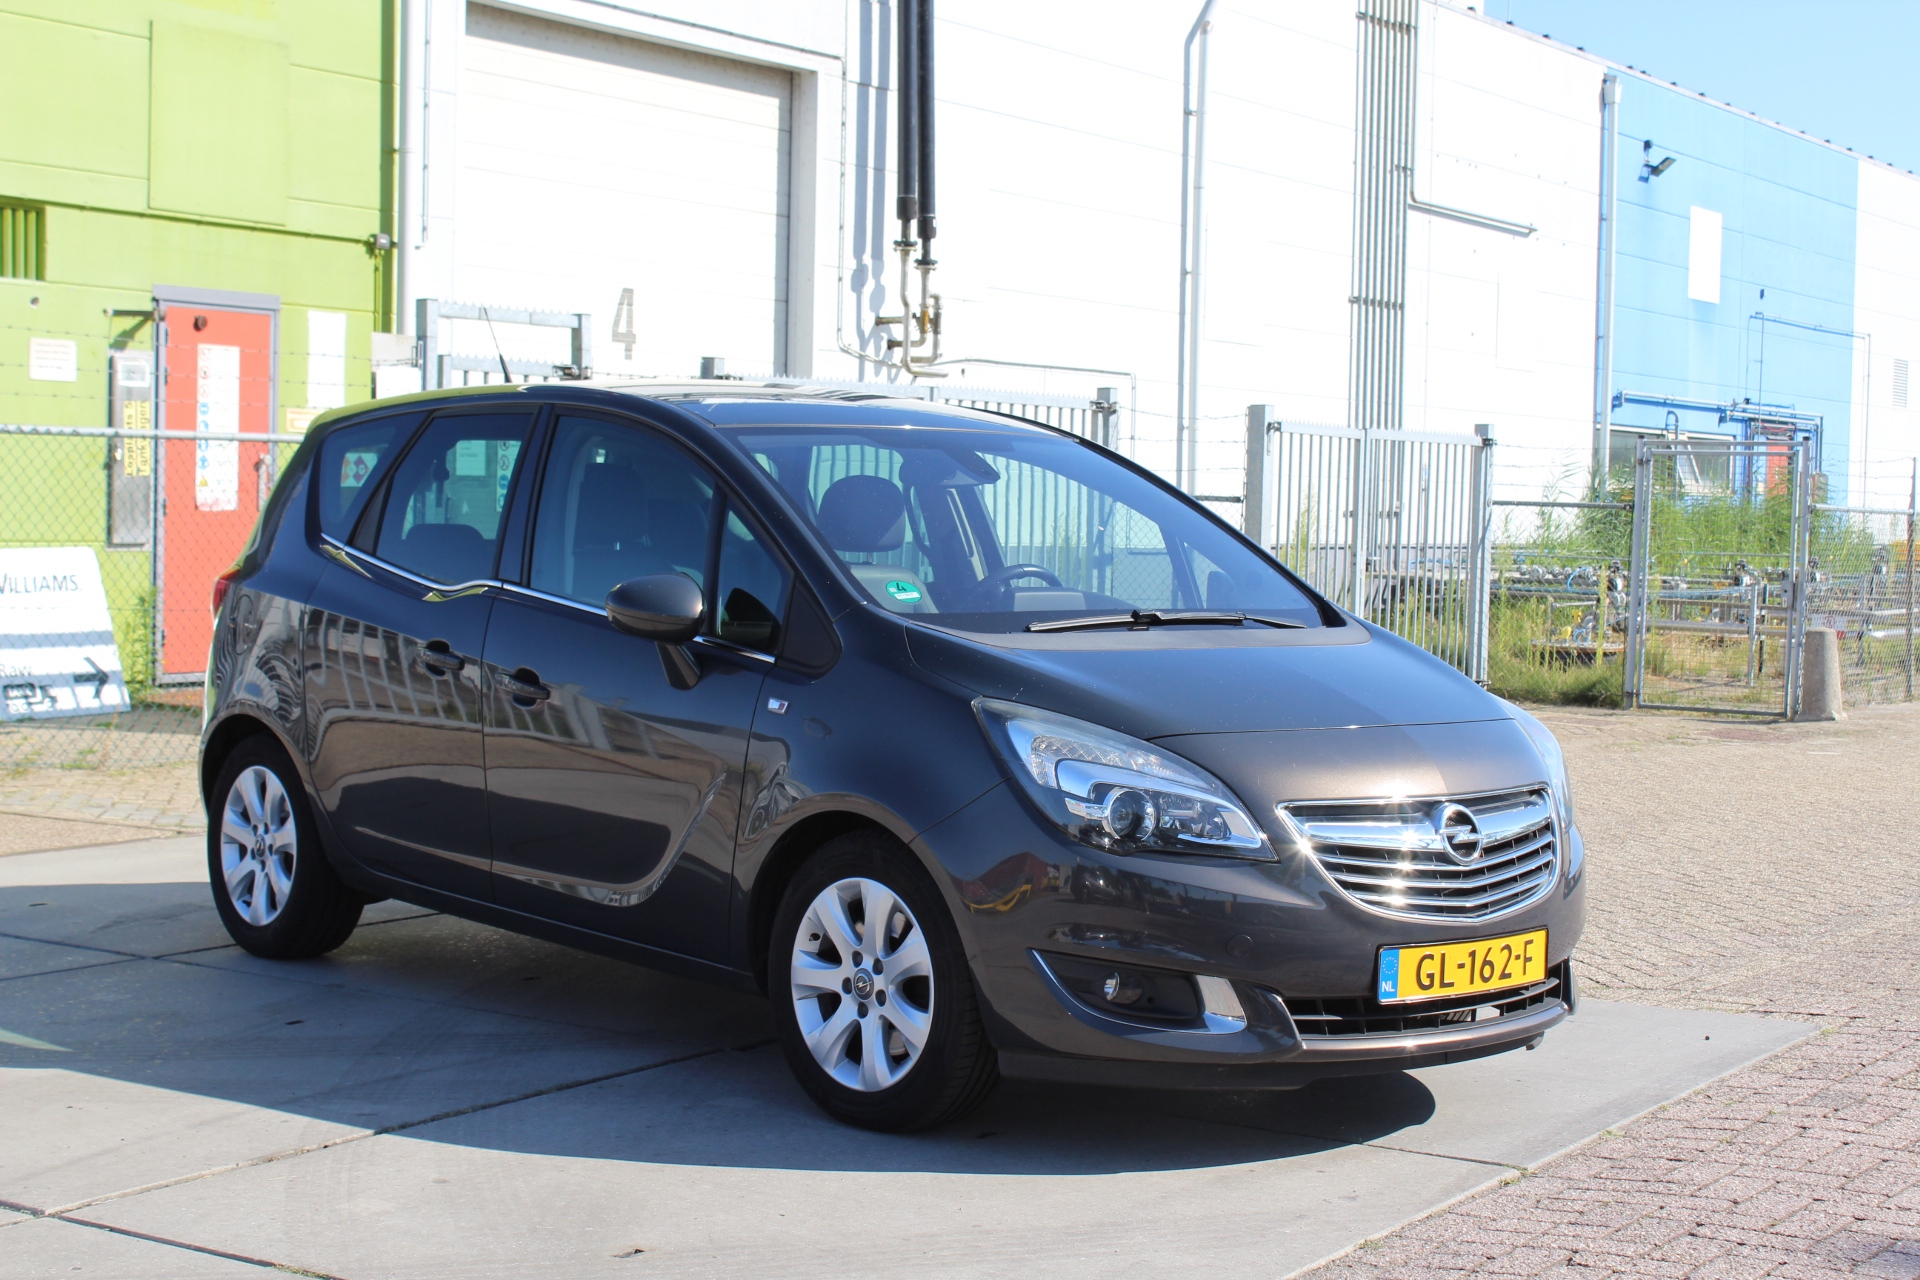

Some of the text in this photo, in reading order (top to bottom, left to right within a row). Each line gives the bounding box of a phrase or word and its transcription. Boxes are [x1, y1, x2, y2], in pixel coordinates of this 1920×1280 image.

[612, 288, 636, 360] 4
[125, 414, 134, 476] Losplts
[137, 401, 149, 476] Tankgen
[896, 582, 907, 591] 4
[1381, 981, 1395, 992] NL
[1415, 939, 1534, 991] GL-162-F
